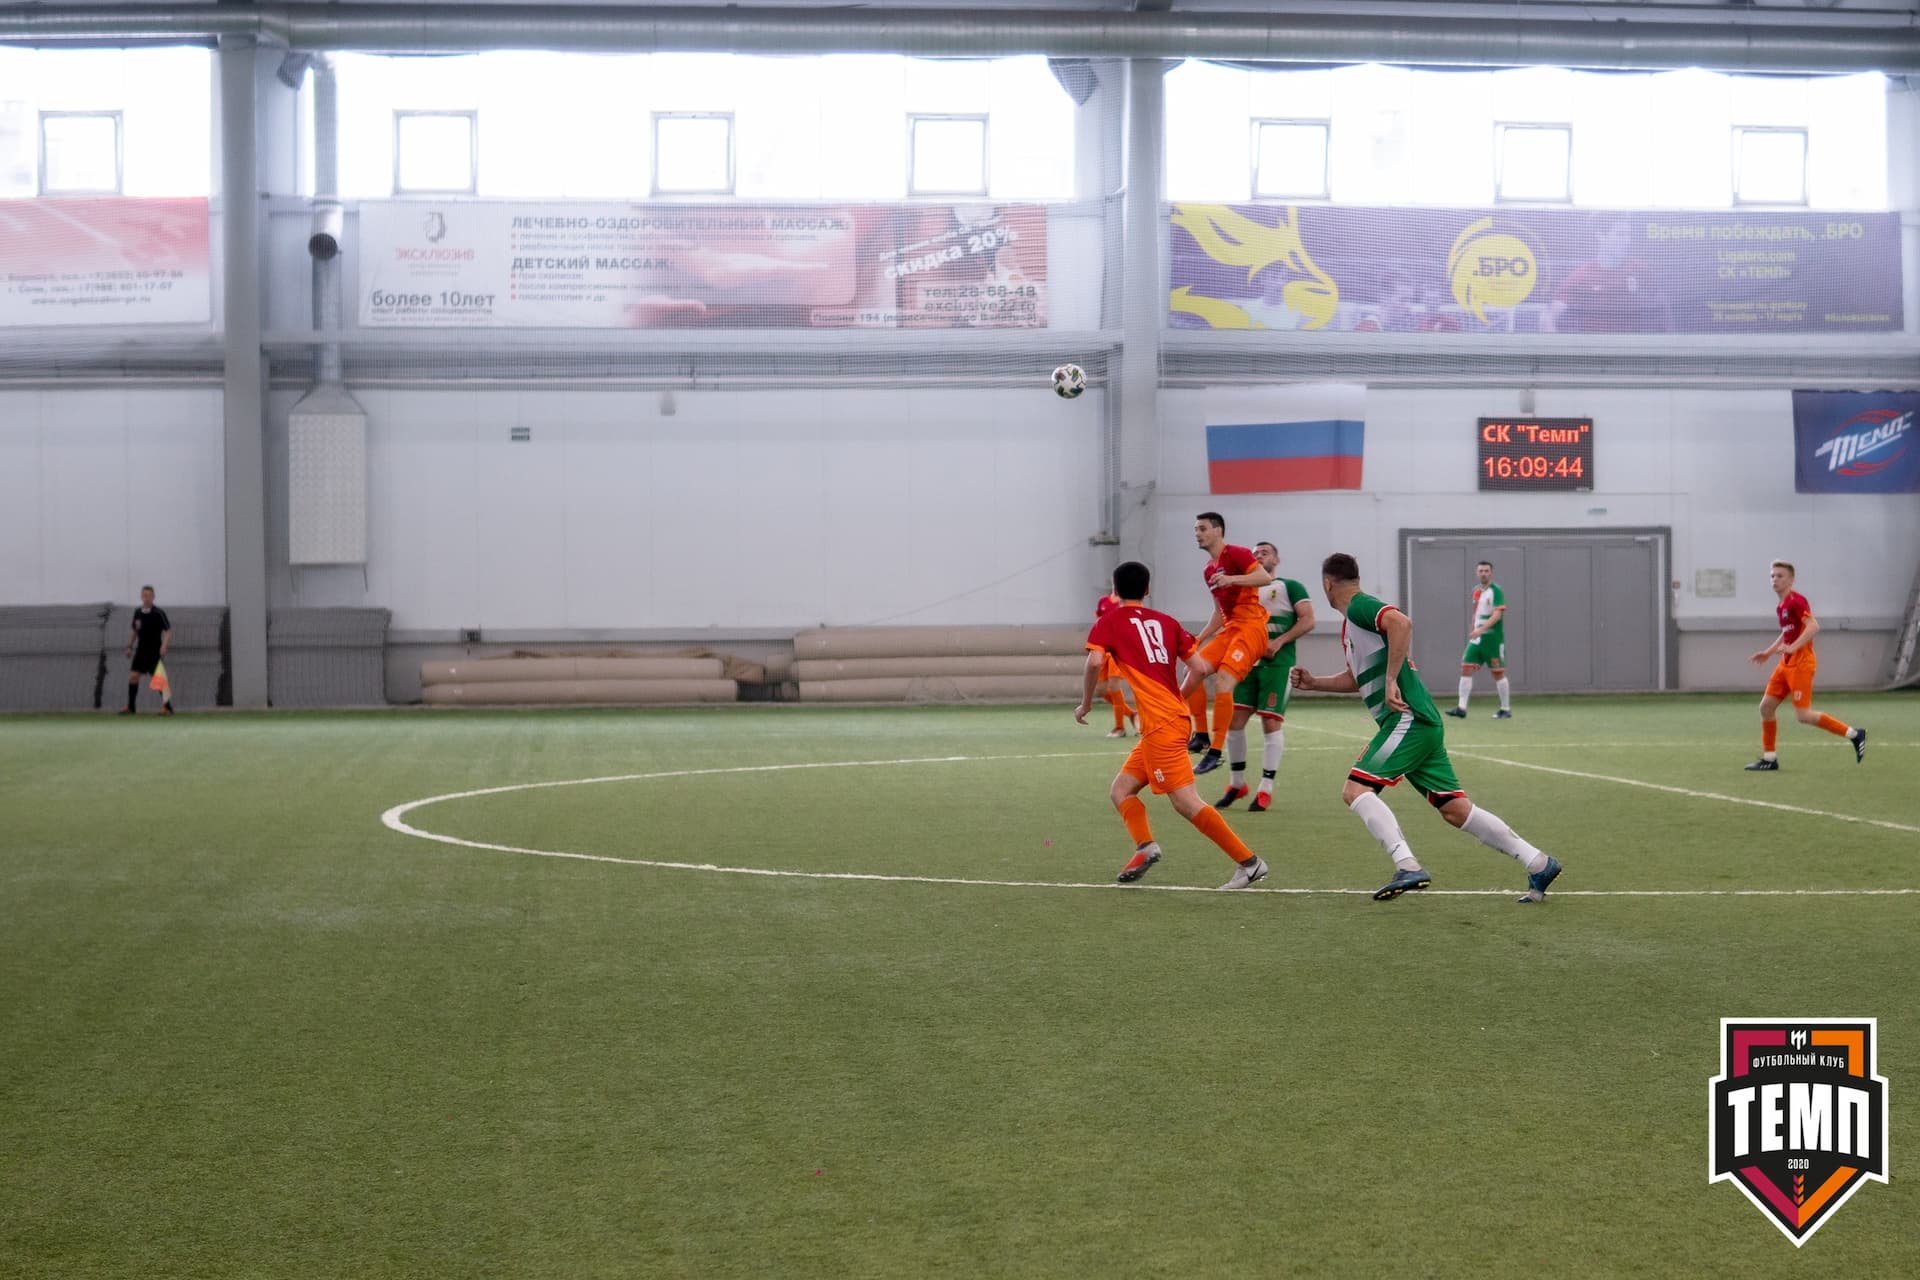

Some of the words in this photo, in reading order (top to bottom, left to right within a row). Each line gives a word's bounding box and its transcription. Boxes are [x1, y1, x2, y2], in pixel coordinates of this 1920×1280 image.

[512, 217, 766, 231] ЛЕЧЕБНО-ОЗДОРОВИТЕЛЬНЫЙ
[1646, 223, 1705, 241] Время
[967, 224, 1018, 254] 20%
[394, 247, 476, 261] ЭКСКЛЮЗИВ
[511, 256, 590, 272] ДЕТСКИЙ
[371, 289, 433, 307] более
[439, 290, 497, 307] 10лет
[1483, 424, 1511, 443] СК
[1516, 424, 1590, 443] "Темп"
[1484, 456, 1583, 478] 16:09:44
